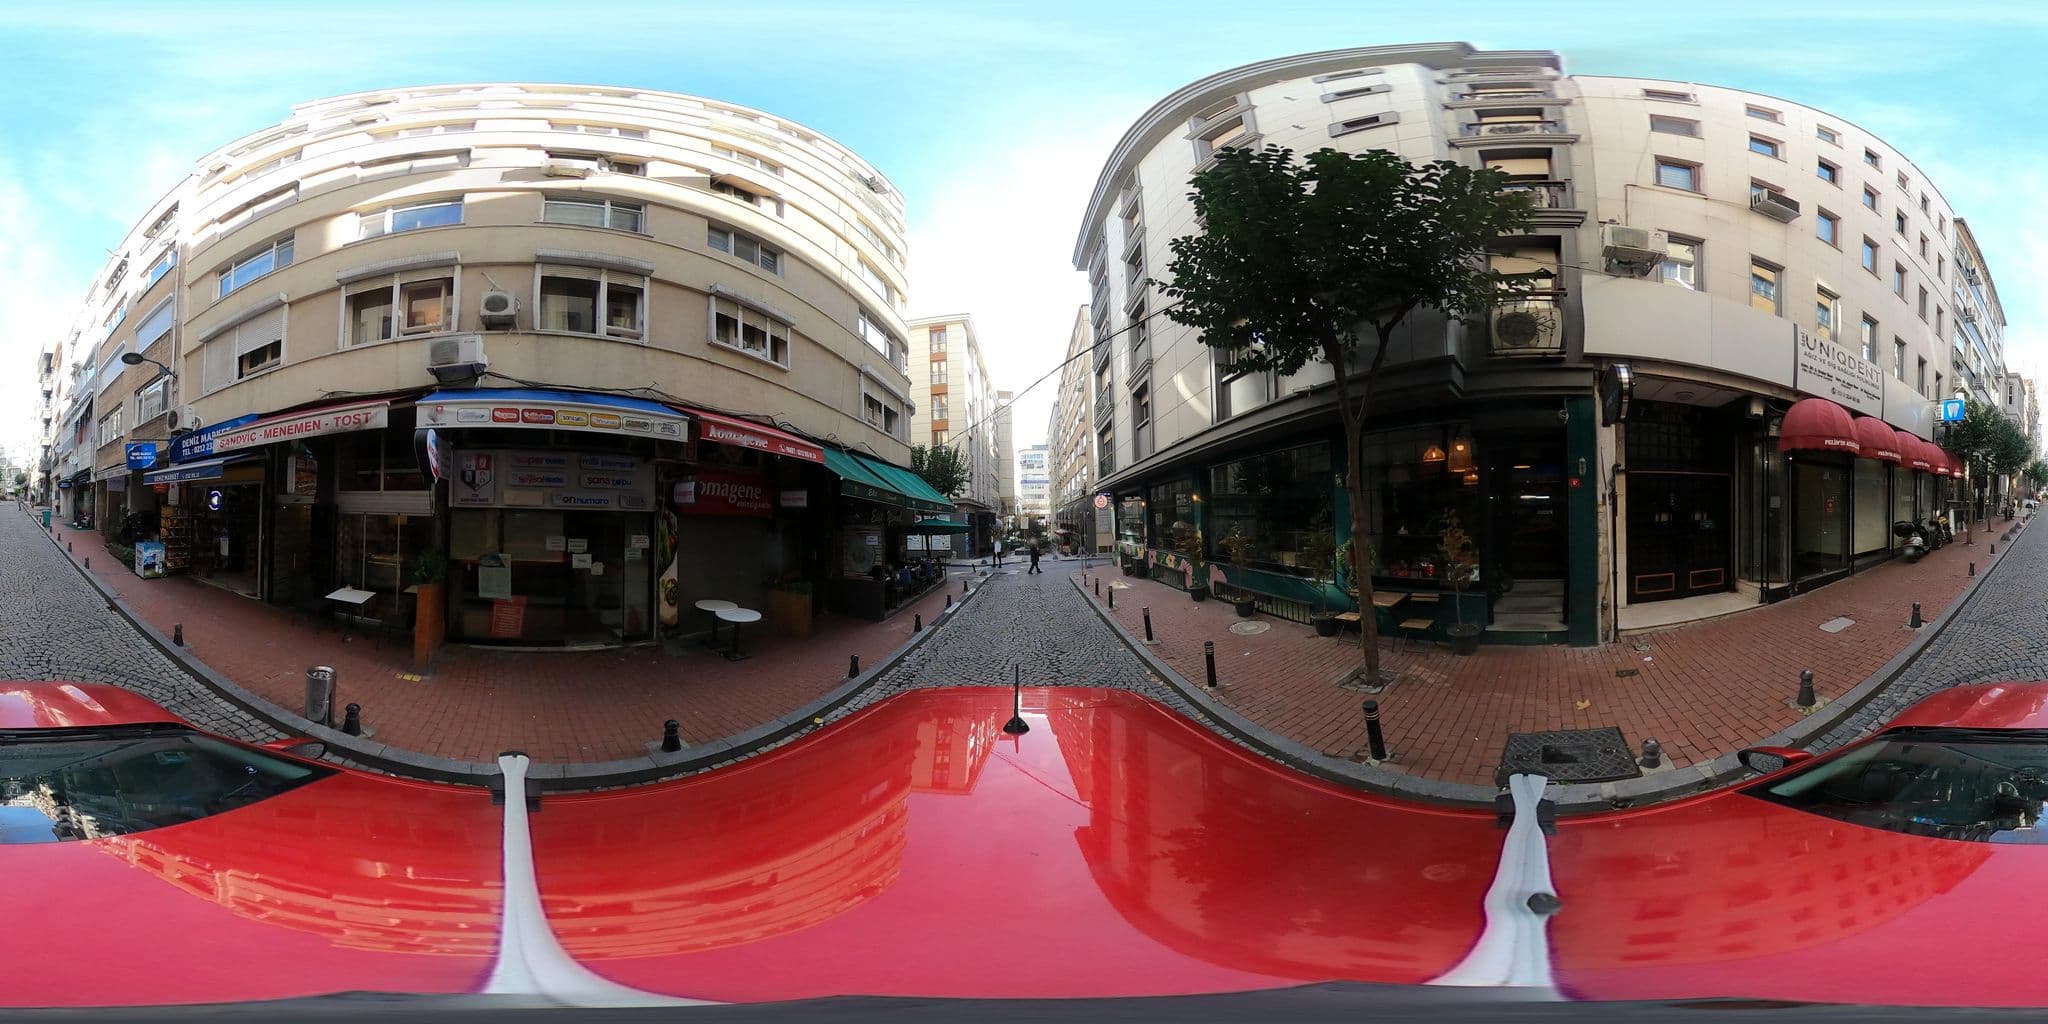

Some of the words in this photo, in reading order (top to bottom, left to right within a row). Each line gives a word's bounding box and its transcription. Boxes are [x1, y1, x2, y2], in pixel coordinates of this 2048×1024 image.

[1805, 334, 1881, 383] UNIQDENT
[263, 419, 321, 438] MENEMEN
[333, 412, 371, 427] TOST
